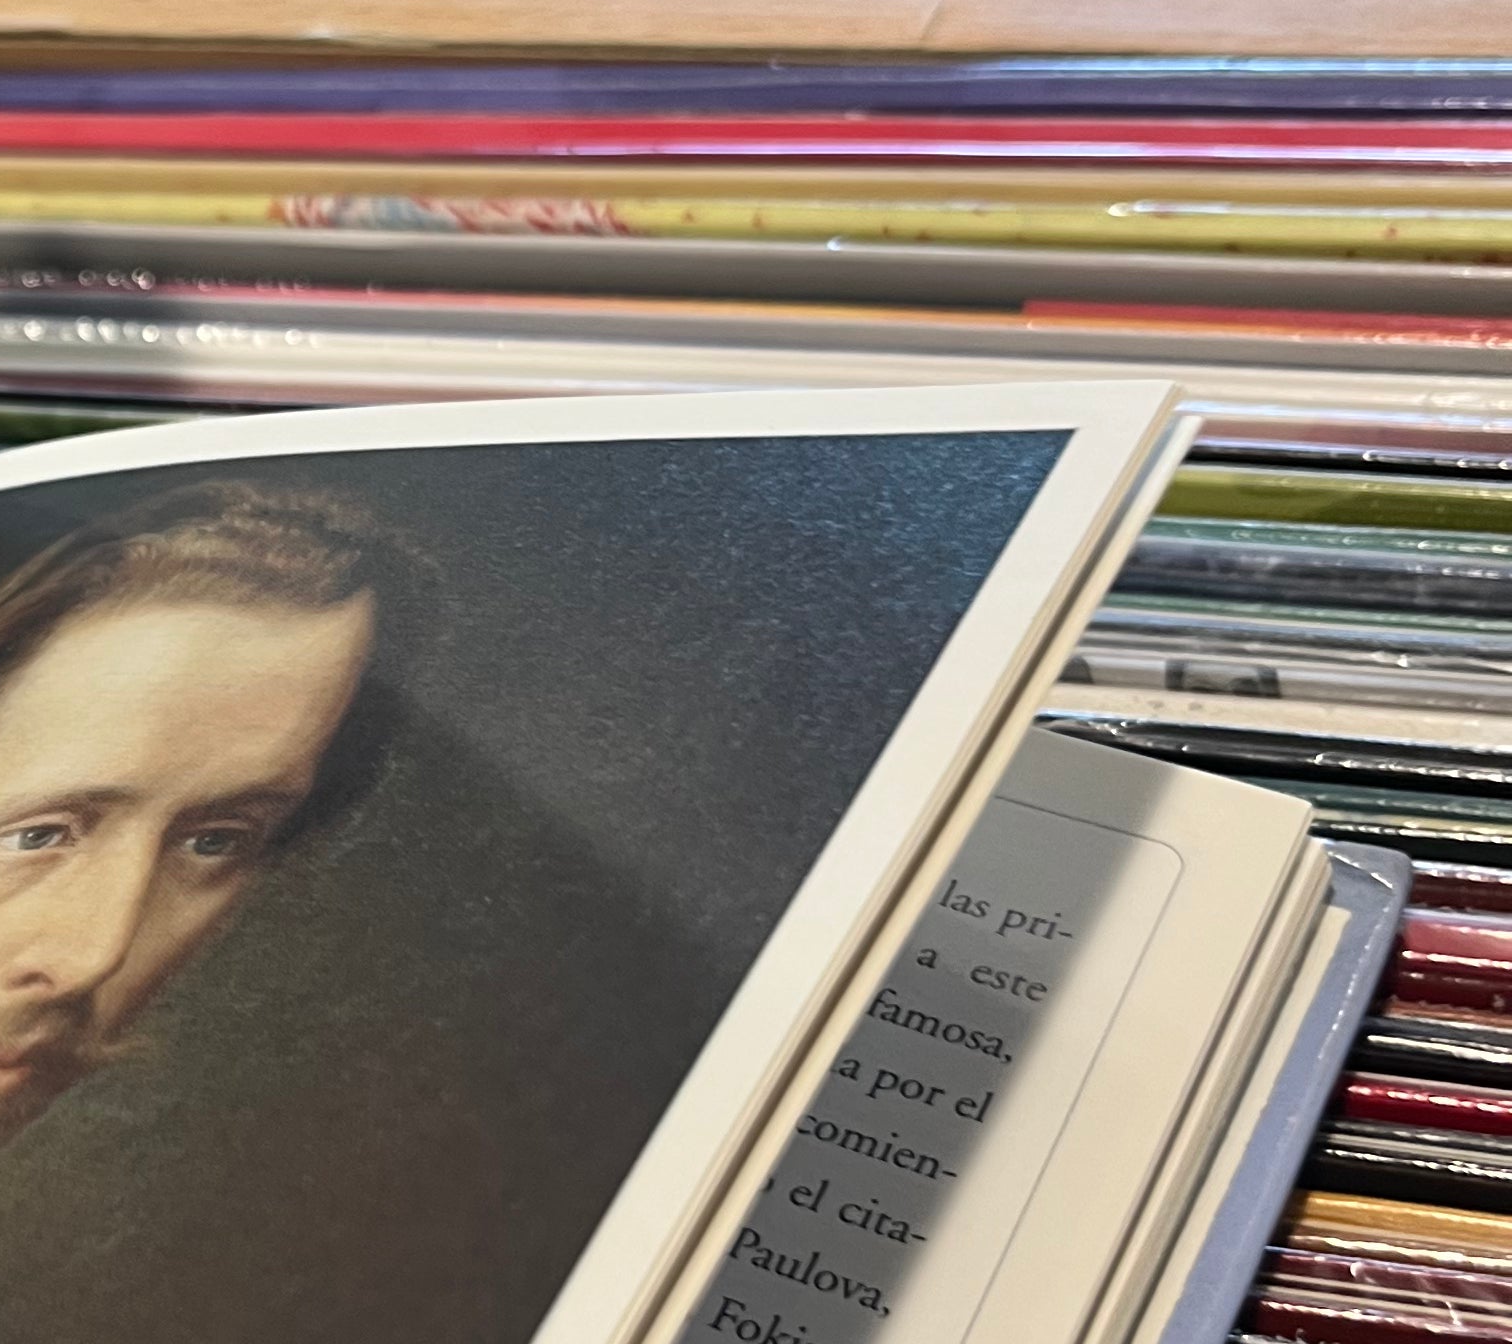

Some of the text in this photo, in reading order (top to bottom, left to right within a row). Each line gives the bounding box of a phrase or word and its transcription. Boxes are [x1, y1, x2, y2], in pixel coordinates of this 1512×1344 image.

[937, 878, 1073, 940] las pri-
[915, 948, 1048, 1002] a este
[865, 987, 1013, 1065] famosa,
[864, 1068, 995, 1124] por el
[788, 1178, 928, 1245] el cita-
[728, 1226, 891, 1319] Paulova,
